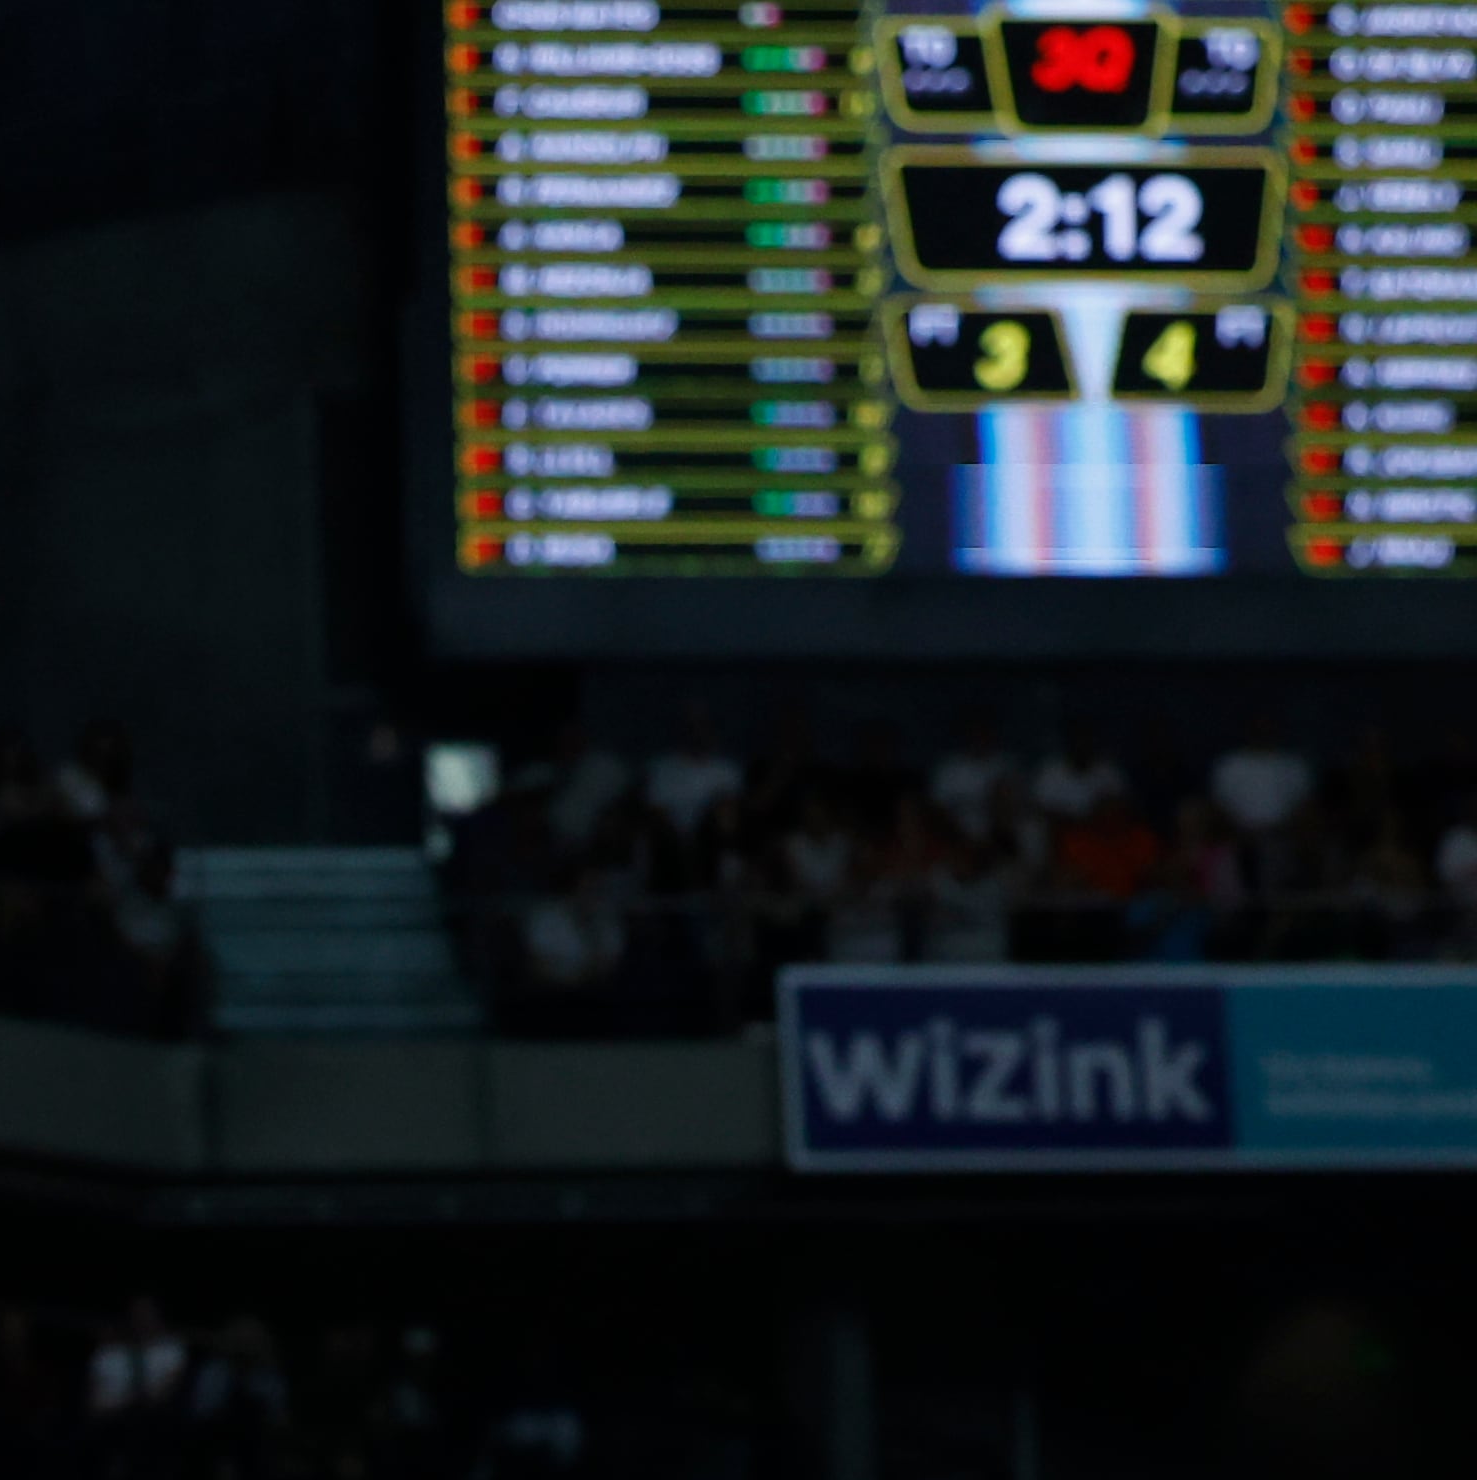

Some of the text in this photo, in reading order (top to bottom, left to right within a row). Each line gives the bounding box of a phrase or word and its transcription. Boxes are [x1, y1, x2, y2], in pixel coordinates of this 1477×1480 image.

[1031, 25, 1135, 94] 30
[995, 171, 1205, 262] 2:12
[972, 319, 1031, 391] 3
[1141, 320, 1198, 391] 4
